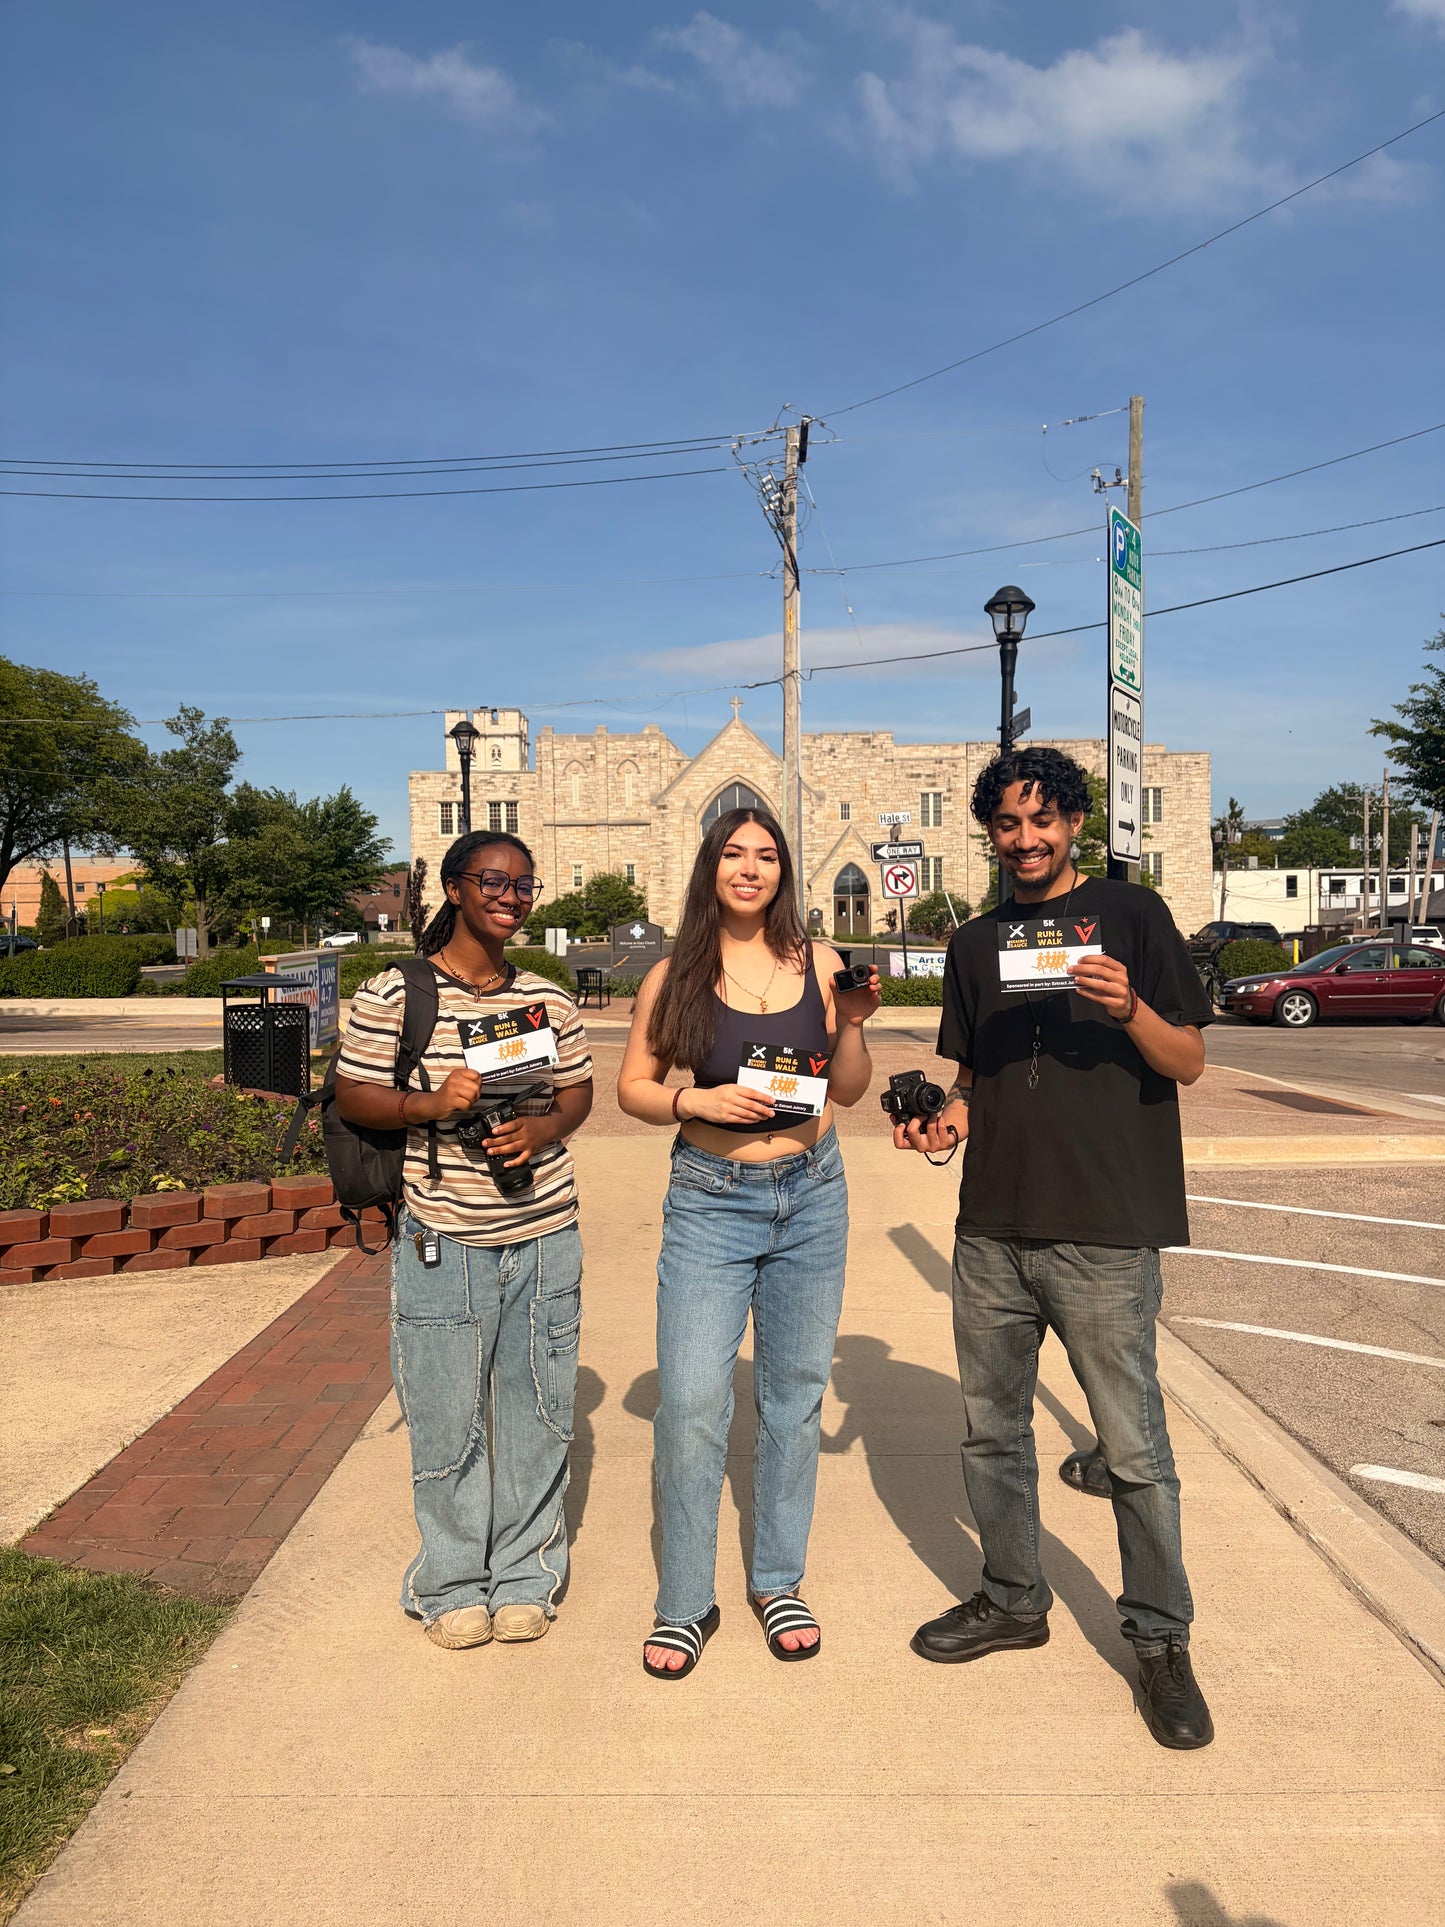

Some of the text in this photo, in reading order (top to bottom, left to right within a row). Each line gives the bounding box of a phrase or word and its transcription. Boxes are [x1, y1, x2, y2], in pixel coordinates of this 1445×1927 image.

[1116, 526, 1124, 560] P
[1132, 531, 1136, 550] 4
[1124, 586, 1130, 604] TO
[1113, 599, 1132, 625] MONDAY
[1120, 624, 1135, 647] FRIDAY
[1116, 638, 1128, 652] EXCEPT
[1120, 652, 1135, 668] HOLIDAYS
[1114, 709, 1140, 742] MOTORCYCLE
[1117, 745, 1138, 773] PARKING
[1121, 782, 1134, 804] ONLY
[880, 813, 910, 824] Hale St
[1037, 930, 1055, 938] RUN
[1037, 938, 1063, 946] WALK
[308, 970, 318, 988] OF
[321, 966, 335, 986] JUNE
[321, 986, 332, 1004] 4-7
[498, 1012, 509, 1020] 5K
[494, 1022, 510, 1032] RUN
[496, 1028, 518, 1038] WALK
[783, 1047, 794, 1055] 5K
[775, 1064, 797, 1072] WALK
[776, 1056, 792, 1064] RUN
